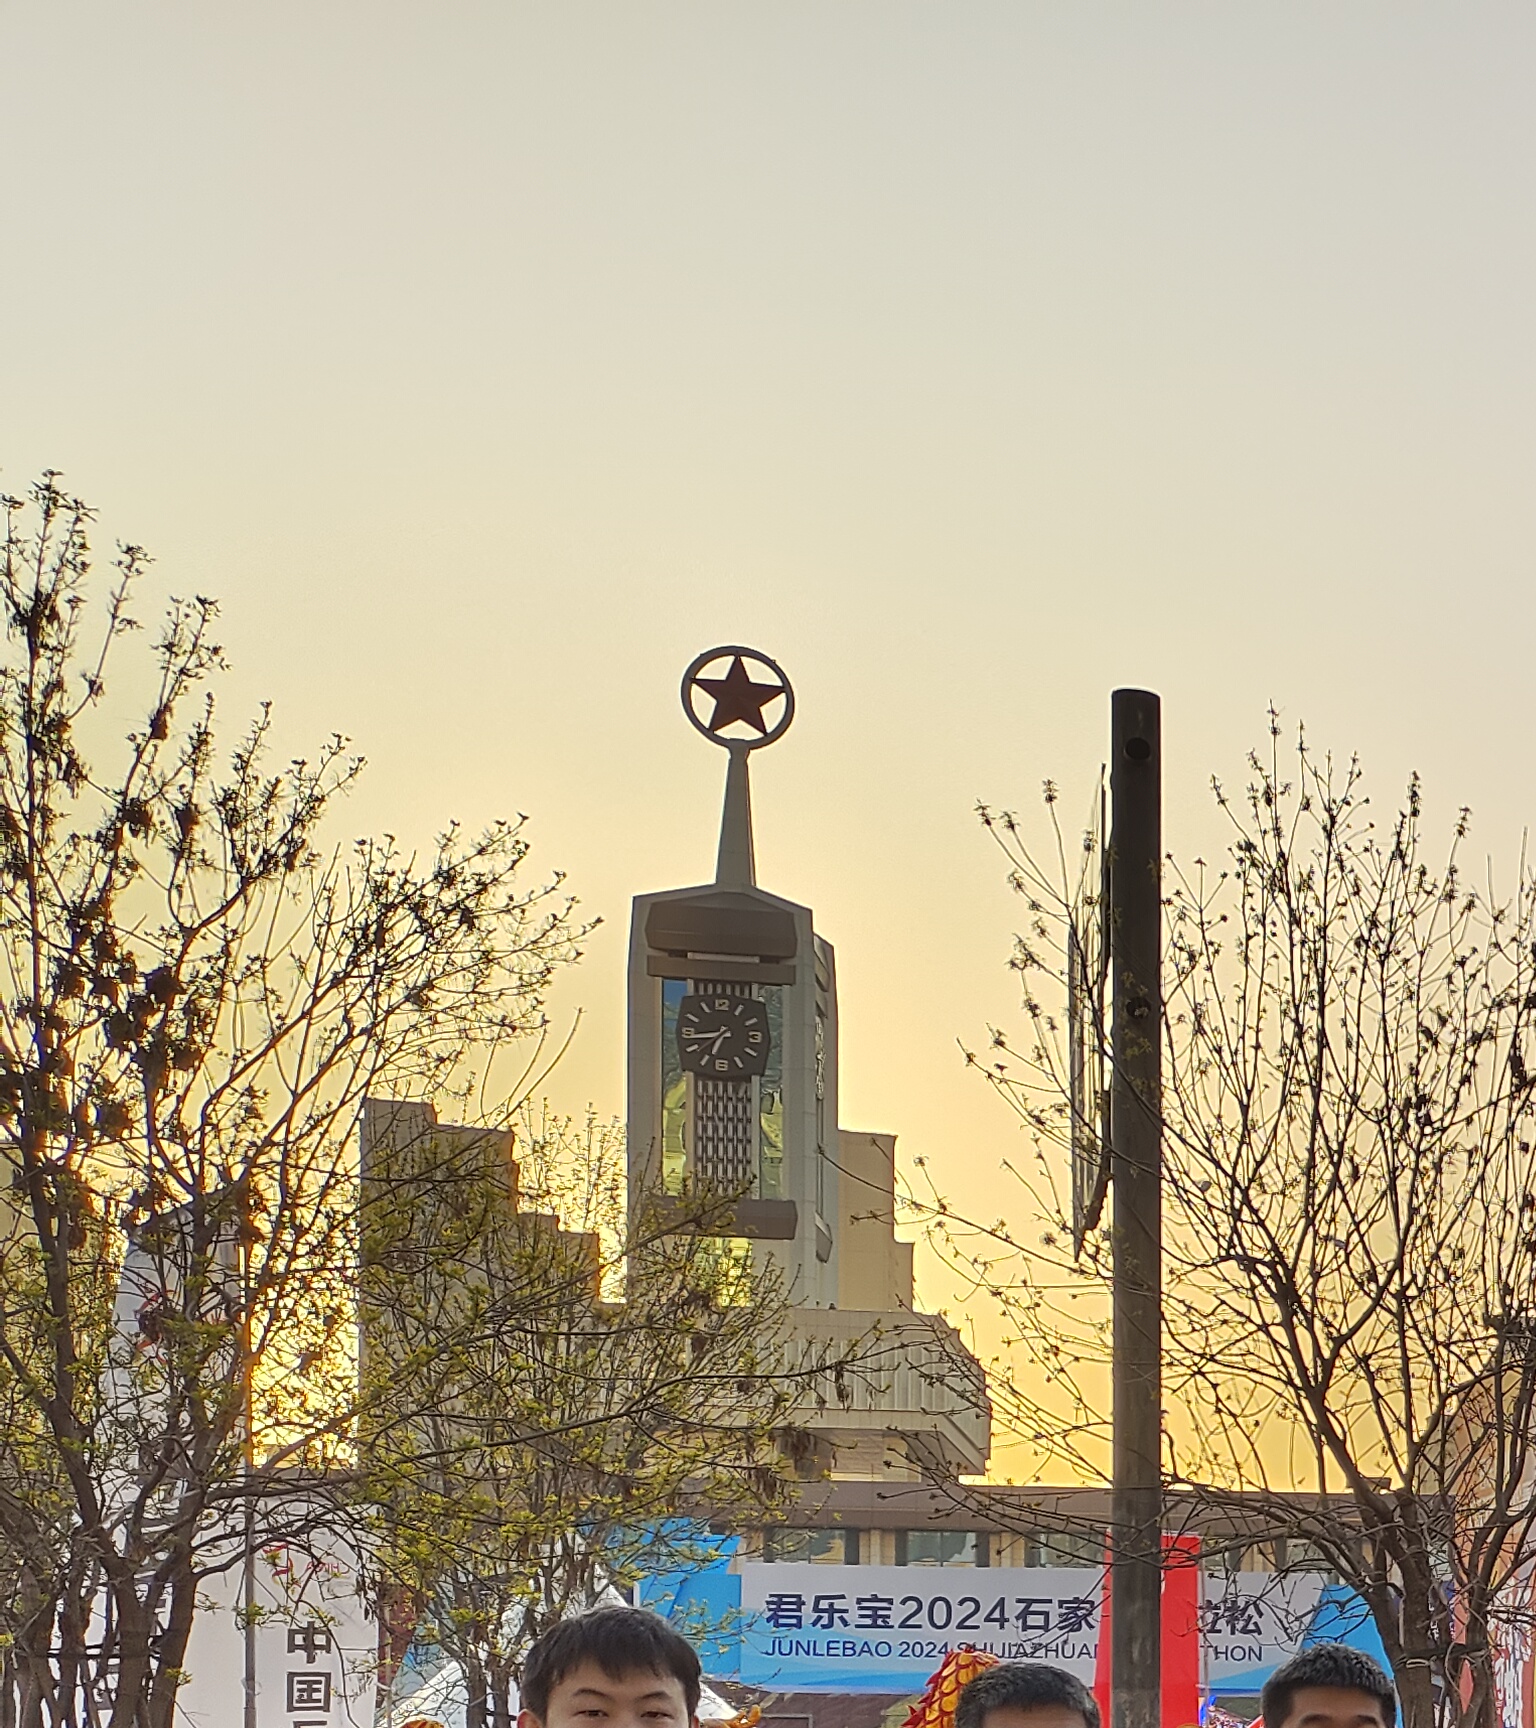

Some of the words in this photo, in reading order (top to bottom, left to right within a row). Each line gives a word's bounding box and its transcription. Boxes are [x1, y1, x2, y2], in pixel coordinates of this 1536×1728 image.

[748, 1031, 762, 1042] 3
[765, 1640, 892, 1658] JUNLEBAO
[898, 1641, 949, 1658] 2024
